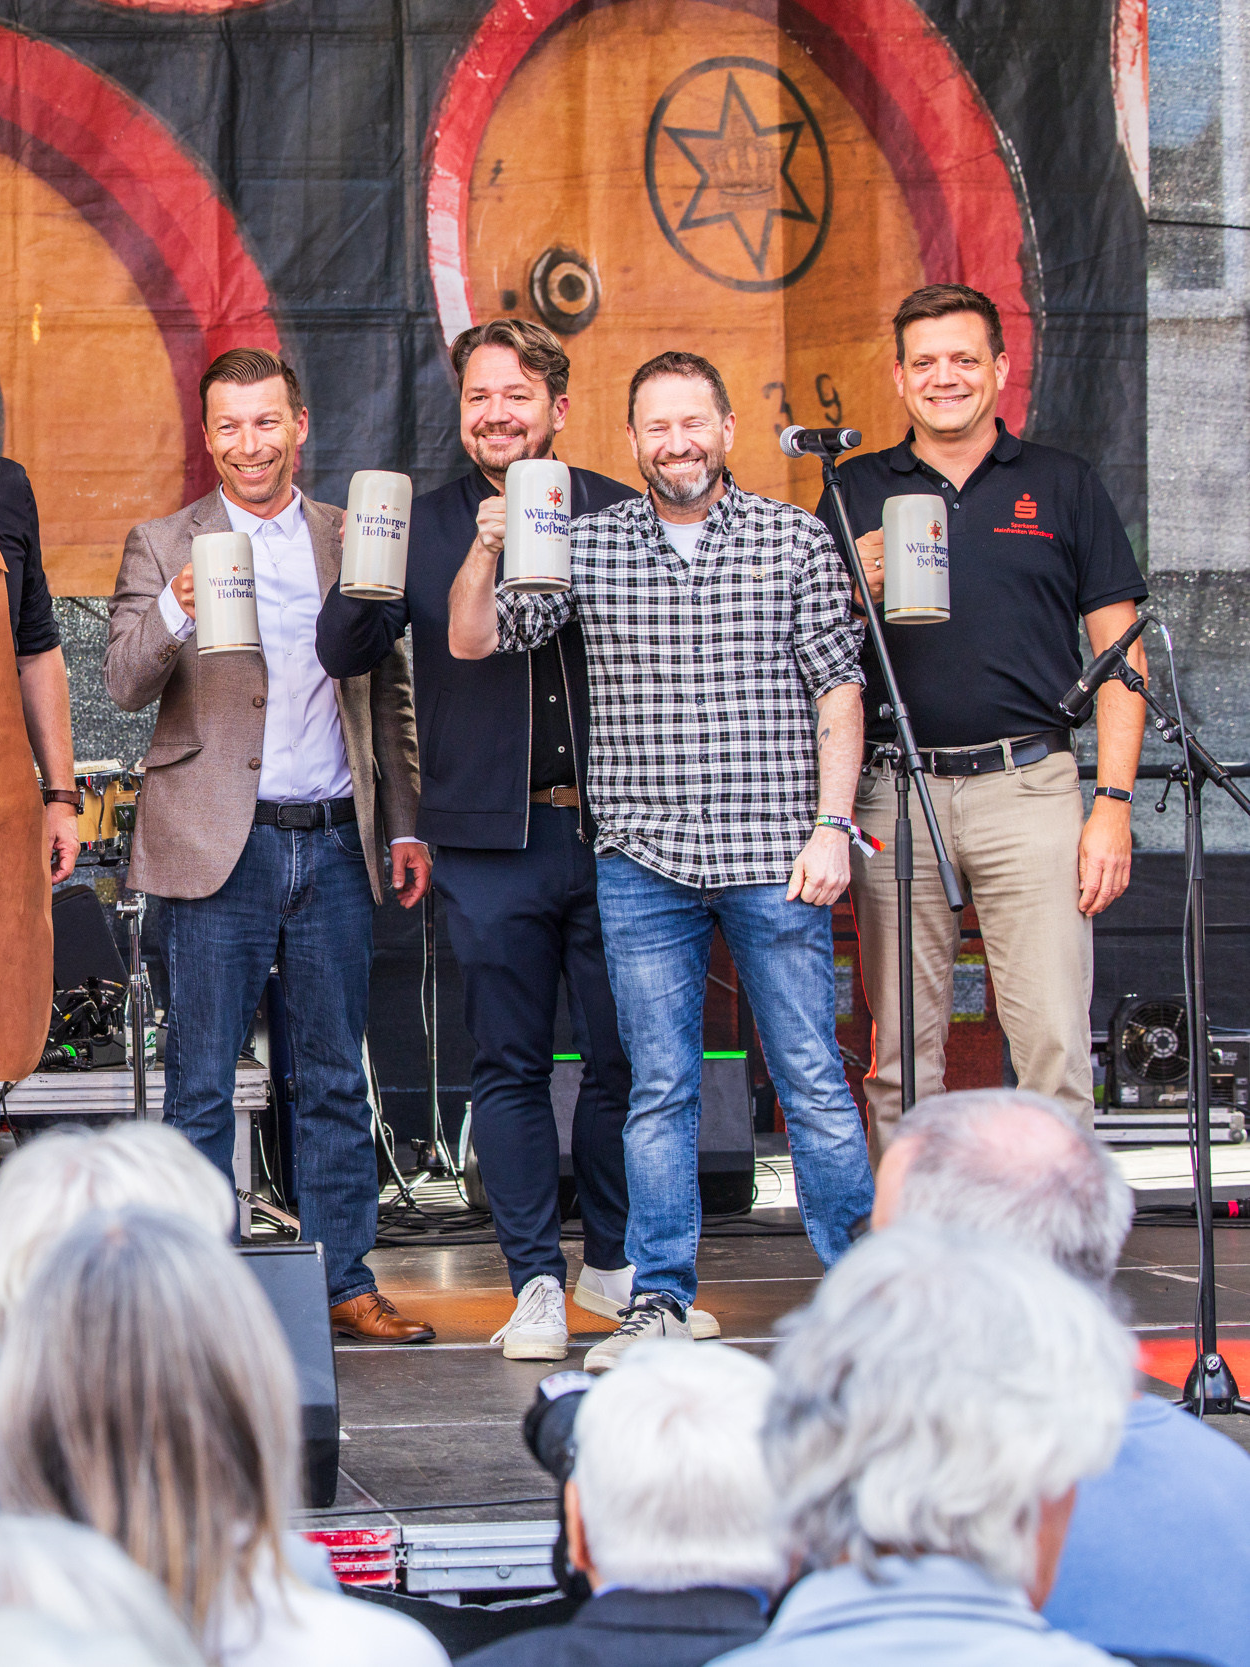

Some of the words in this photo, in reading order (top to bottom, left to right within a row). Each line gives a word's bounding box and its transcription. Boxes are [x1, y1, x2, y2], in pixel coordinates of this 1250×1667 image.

[356, 513, 407, 531] Würzburger
[524, 508, 571, 527] Würzburg
[362, 525, 402, 540] Hofbräu
[1010, 521, 1039, 530] Sparkasse
[993, 527, 1028, 535] Mainfranken
[1028, 529, 1054, 540] Würzburg
[906, 542, 949, 559] Würzburg
[208, 576, 255, 590] Würzburge
[217, 588, 254, 599] Hofbräu
